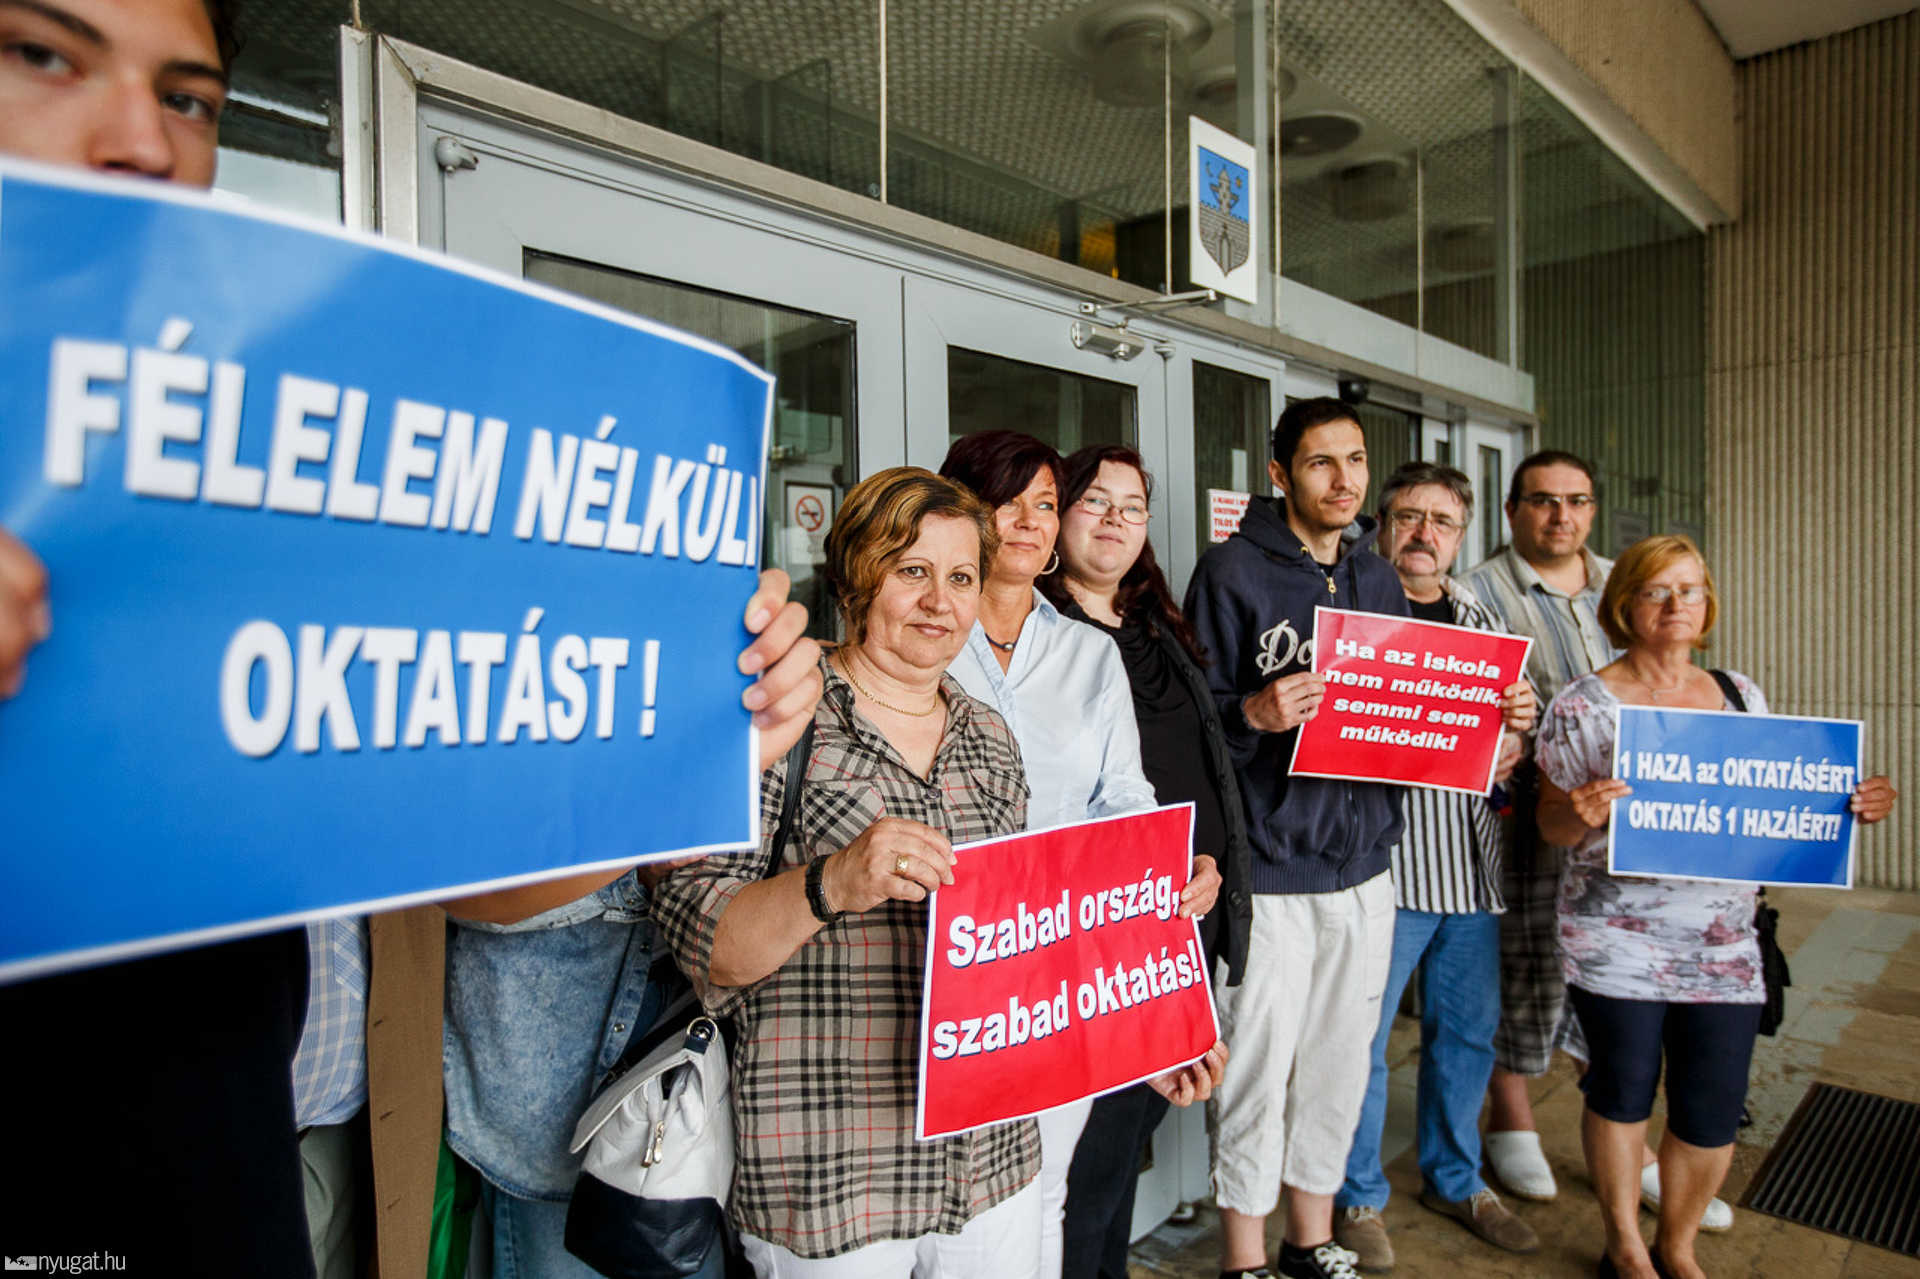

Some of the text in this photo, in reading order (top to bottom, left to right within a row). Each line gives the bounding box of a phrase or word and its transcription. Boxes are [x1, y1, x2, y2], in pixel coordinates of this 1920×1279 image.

[46, 317, 757, 567] FÉLELEM NÉLKÜLI
[1325, 669, 1383, 690] nem
[1335, 638, 1501, 680] Ha az iskola
[221, 607, 660, 758] OKTATÁST !
[1333, 697, 1480, 728] semmi sem
[1340, 723, 1458, 752] működik!
[1620, 750, 1631, 778] 1
[1637, 752, 1692, 783] HAZA
[1696, 762, 1719, 785] az
[1628, 798, 1842, 841] OKTATÁS 1 HAZÁÉRT!
[947, 868, 1180, 968] Szabad ország,
[932, 939, 1203, 1060] szabad oktatás!
